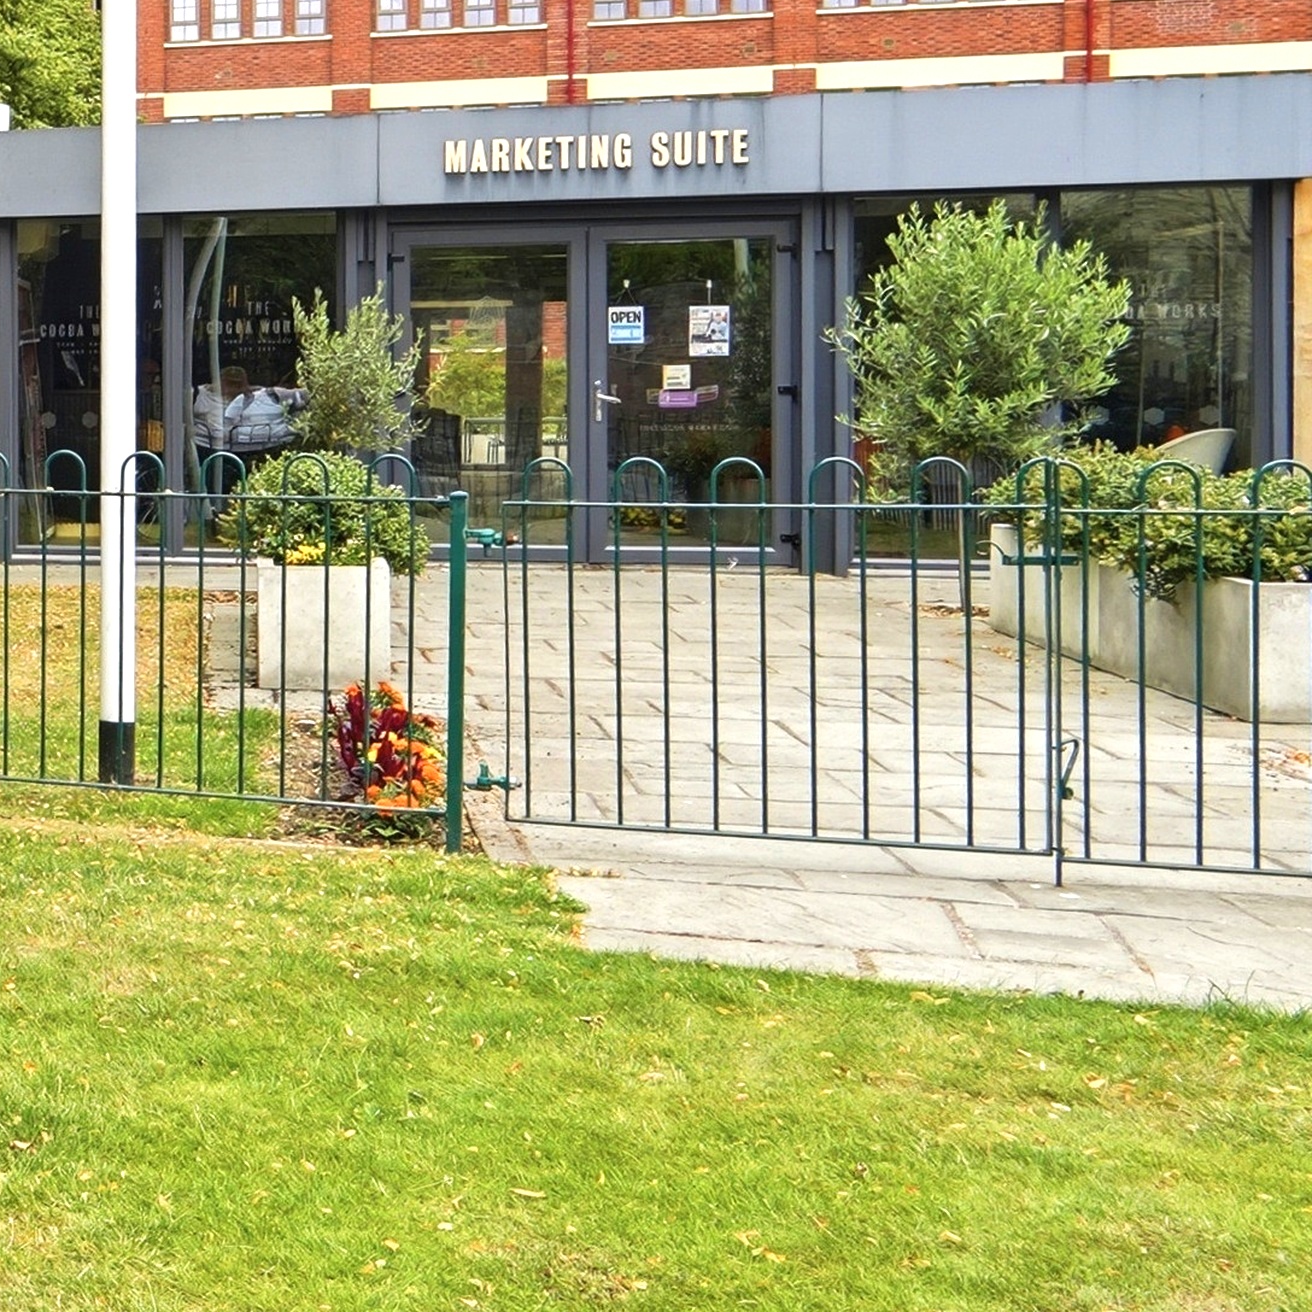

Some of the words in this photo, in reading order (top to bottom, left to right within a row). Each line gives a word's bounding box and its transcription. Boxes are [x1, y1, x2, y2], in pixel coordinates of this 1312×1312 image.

[444, 131, 633, 175] MARKETING
[651, 128, 750, 168] SUITE
[610, 310, 642, 325] OPEN
